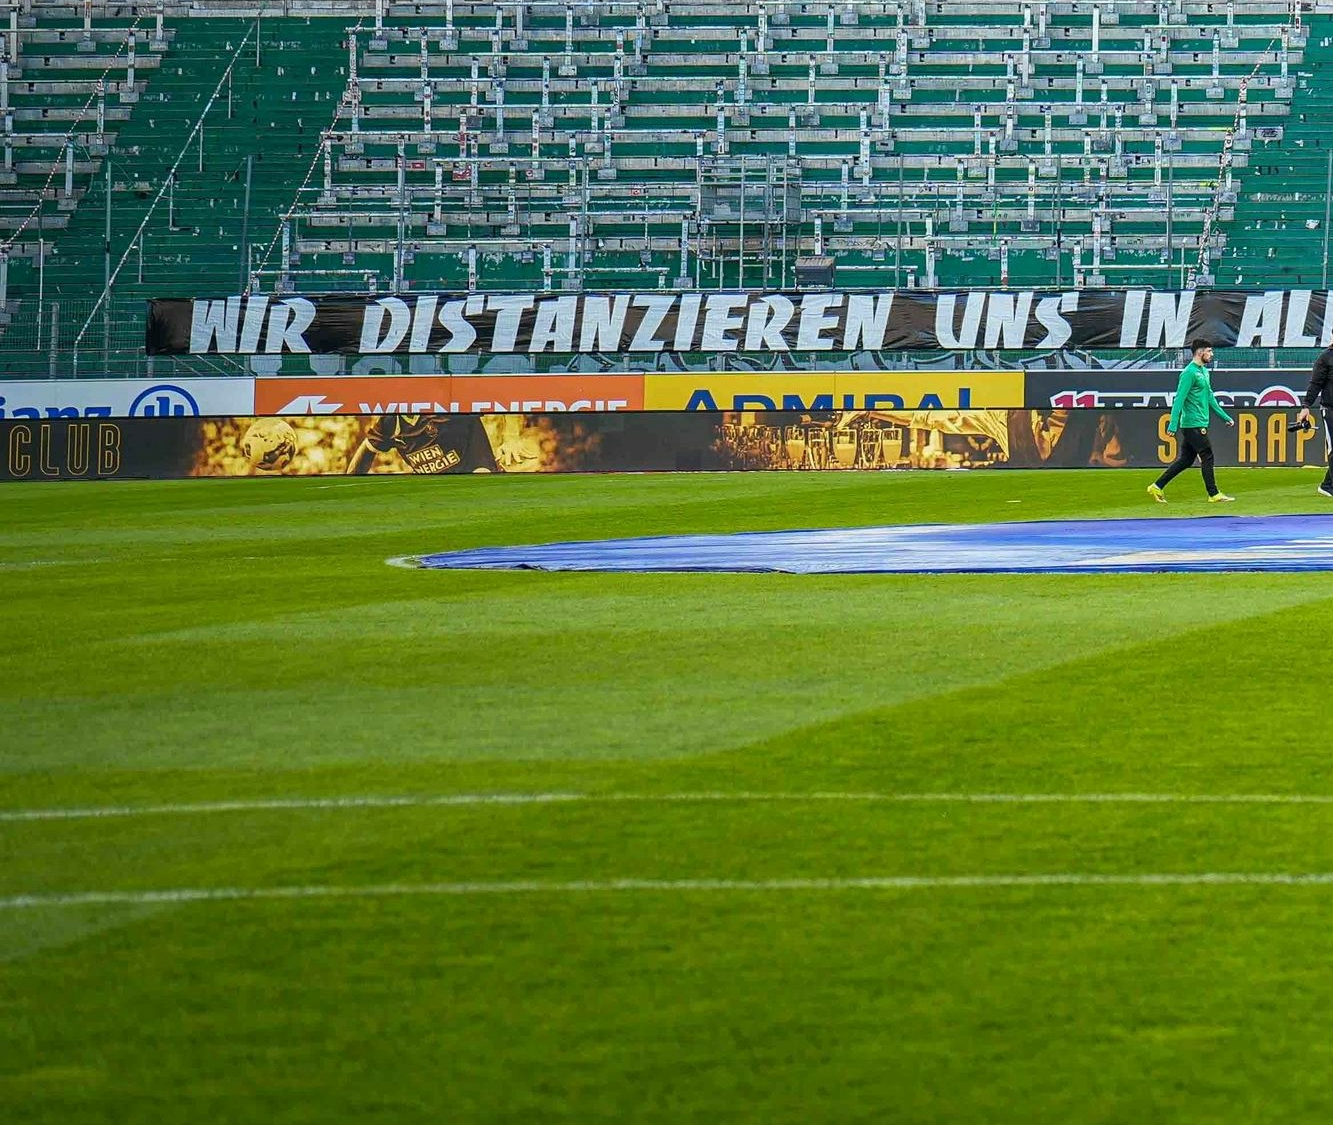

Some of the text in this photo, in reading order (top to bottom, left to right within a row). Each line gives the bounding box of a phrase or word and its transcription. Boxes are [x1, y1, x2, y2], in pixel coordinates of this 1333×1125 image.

[188, 294, 320, 354] WIR
[358, 292, 894, 354] DISTANZIEREN
[933, 290, 1080, 350] UNS
[1119, 289, 1197, 349] IN
[9, 424, 121, 476] CLUB
[408, 446, 441, 464] WIEN
[1238, 413, 1329, 463] RAP
